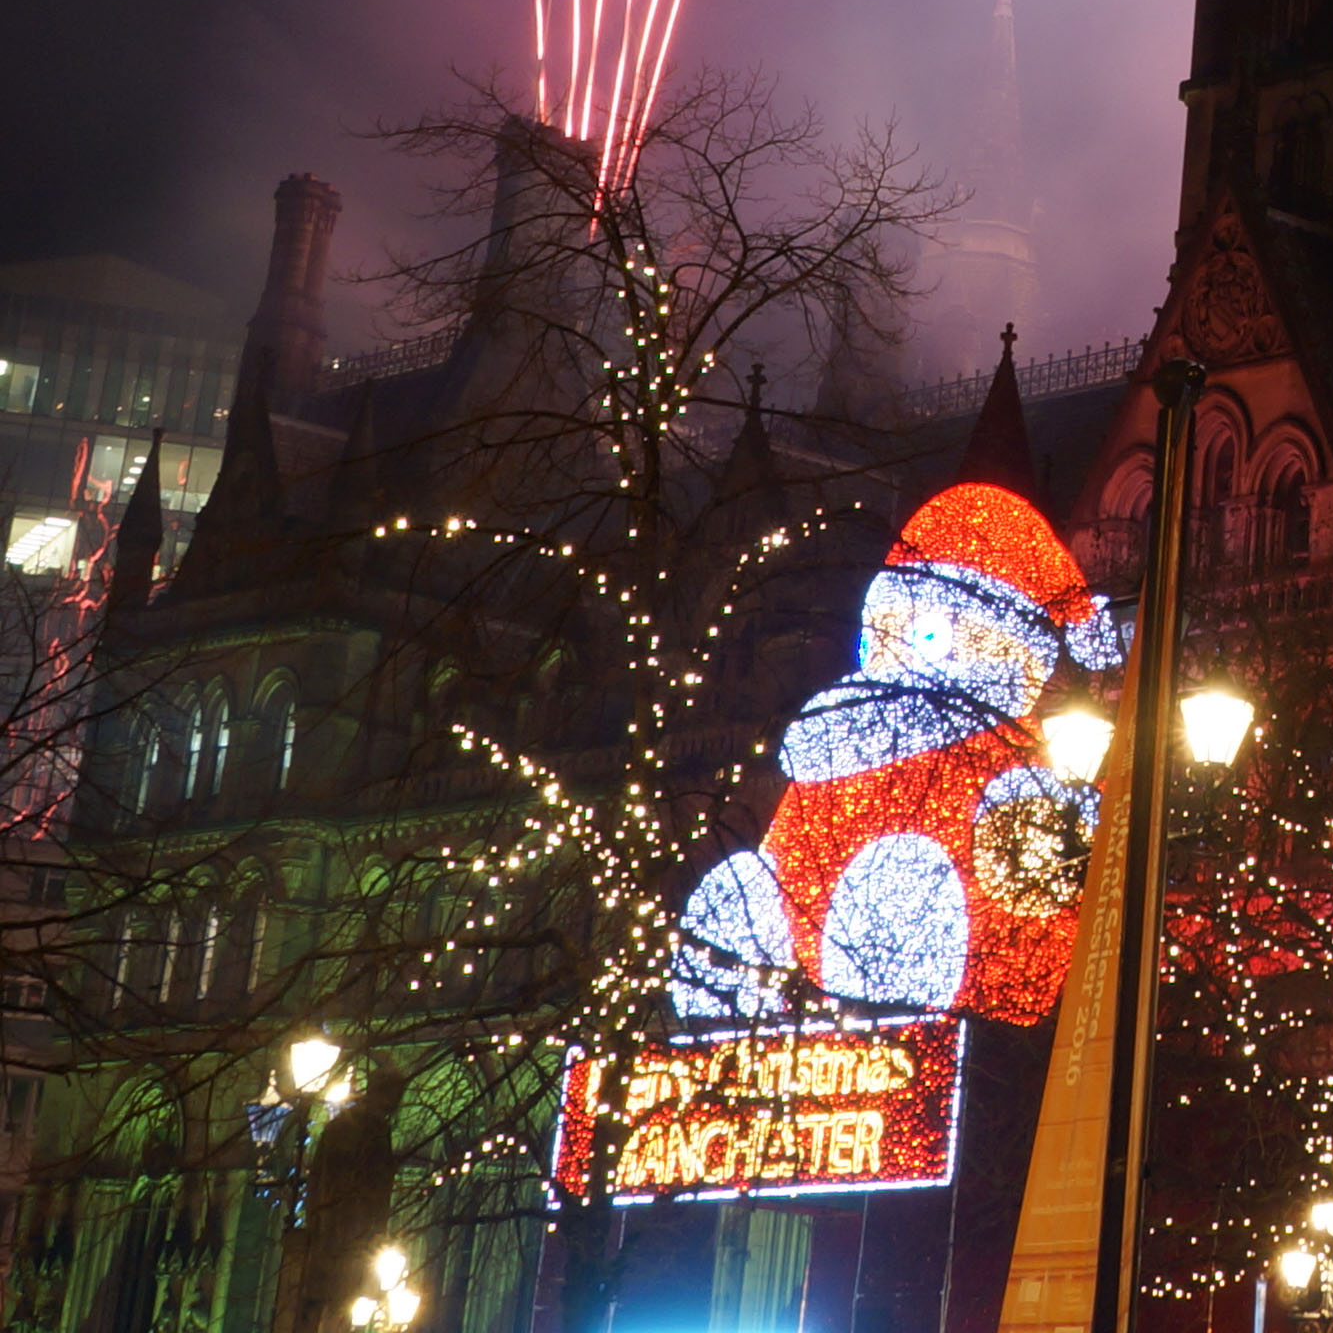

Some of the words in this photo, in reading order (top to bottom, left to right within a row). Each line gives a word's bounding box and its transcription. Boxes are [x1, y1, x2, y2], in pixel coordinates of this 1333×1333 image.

[1081, 800, 1122, 998] Manchester
[1087, 907, 1119, 1039] Science
[1065, 1006, 1089, 1087] 2016
